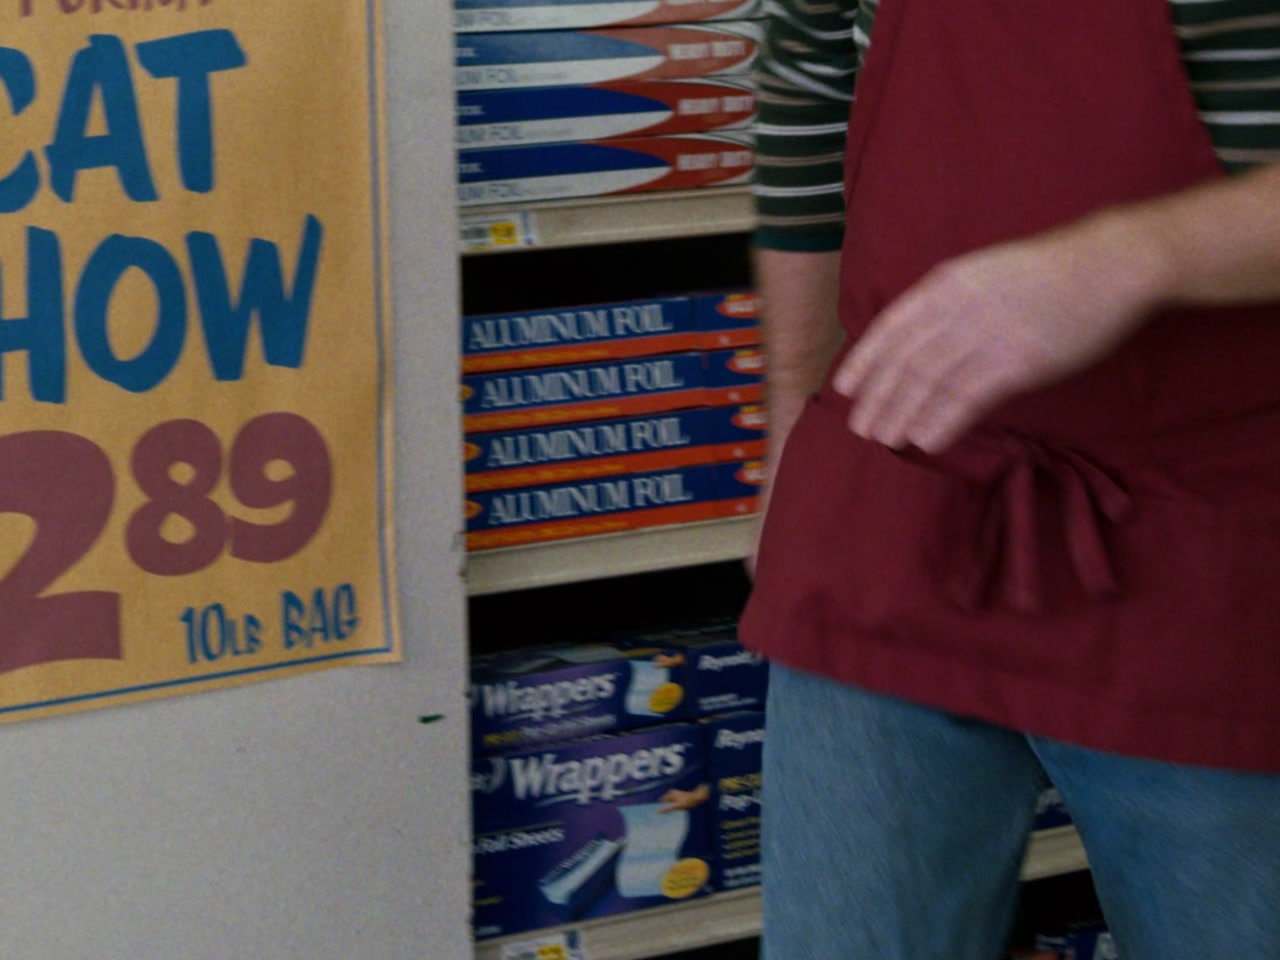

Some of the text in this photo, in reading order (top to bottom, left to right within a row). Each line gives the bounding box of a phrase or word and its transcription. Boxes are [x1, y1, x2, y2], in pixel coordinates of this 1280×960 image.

[469, 303, 674, 350] ALUMINUM FOIL
[480, 360, 685, 408] ALUMINUM FOIL
[487, 417, 691, 467] ALUMINUM FOIL
[488, 474, 694, 525] ALUMINUM FOIL
[281, 582, 361, 650] BAG
[482, 671, 618, 721] Wrappers
[509, 743, 685, 805] Wrappers
